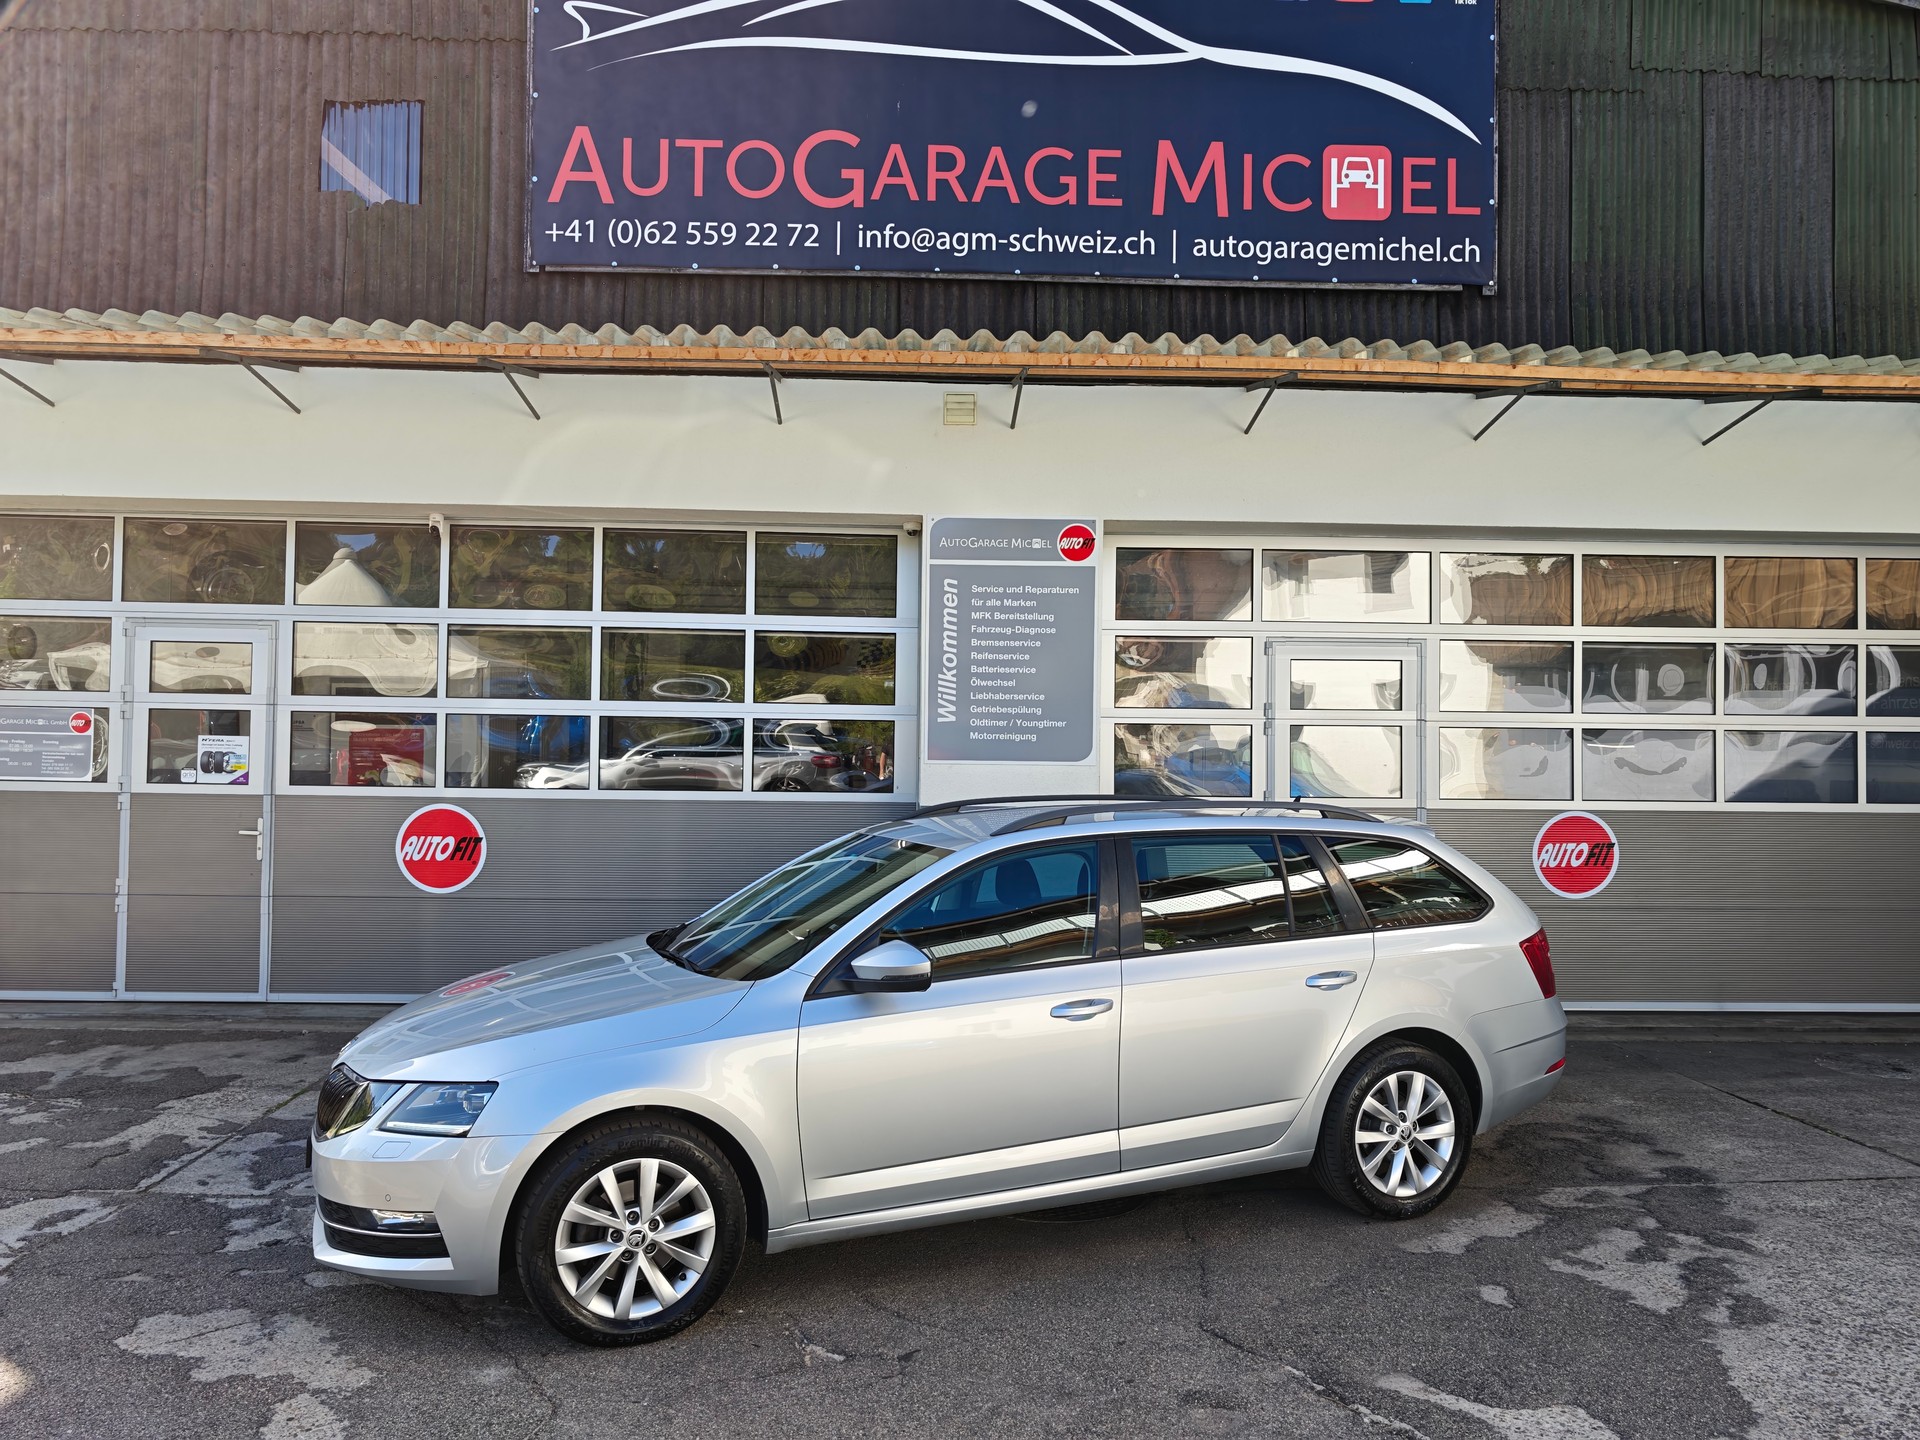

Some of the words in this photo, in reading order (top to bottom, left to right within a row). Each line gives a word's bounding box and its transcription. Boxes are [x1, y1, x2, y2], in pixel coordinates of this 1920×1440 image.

[545, 219, 596, 243] +41
[608, 219, 677, 247] (0)62
[686, 221, 737, 246] 559
[745, 223, 779, 247] 22
[787, 223, 820, 248] 72
[857, 223, 1156, 257] info@agm-schweiz.ch
[1193, 234, 1481, 267] autogaragemichel.ch
[1058, 537, 1095, 550] AUTOFIT
[971, 585, 1004, 594] Service
[1006, 585, 1023, 594] und
[1025, 586, 1080, 596] Reparaturen
[971, 598, 984, 607] für
[986, 598, 1001, 607] alle
[1003, 599, 1037, 607] Marken
[971, 612, 992, 620] MFK
[994, 612, 1055, 623] Bereitstellung
[971, 625, 1057, 636] Fahrzeug-Diagnose
[971, 638, 1041, 647] Bremsenservice
[937, 578, 958, 723] Willkommen
[971, 652, 1030, 661] Reifenservice
[971, 665, 1037, 674] Batterieservice
[970, 677, 1016, 687] Ölwechsel
[970, 692, 1045, 701] Liebhaberservice
[970, 705, 1042, 716] Getriebespülung
[970, 718, 1007, 728] Oldtimer
[1016, 719, 1067, 729] Youngtimer
[970, 732, 1037, 742] Motorreinigung
[402, 835, 483, 862] AUTOFIT
[1538, 842, 1616, 868] AUTOFIT
